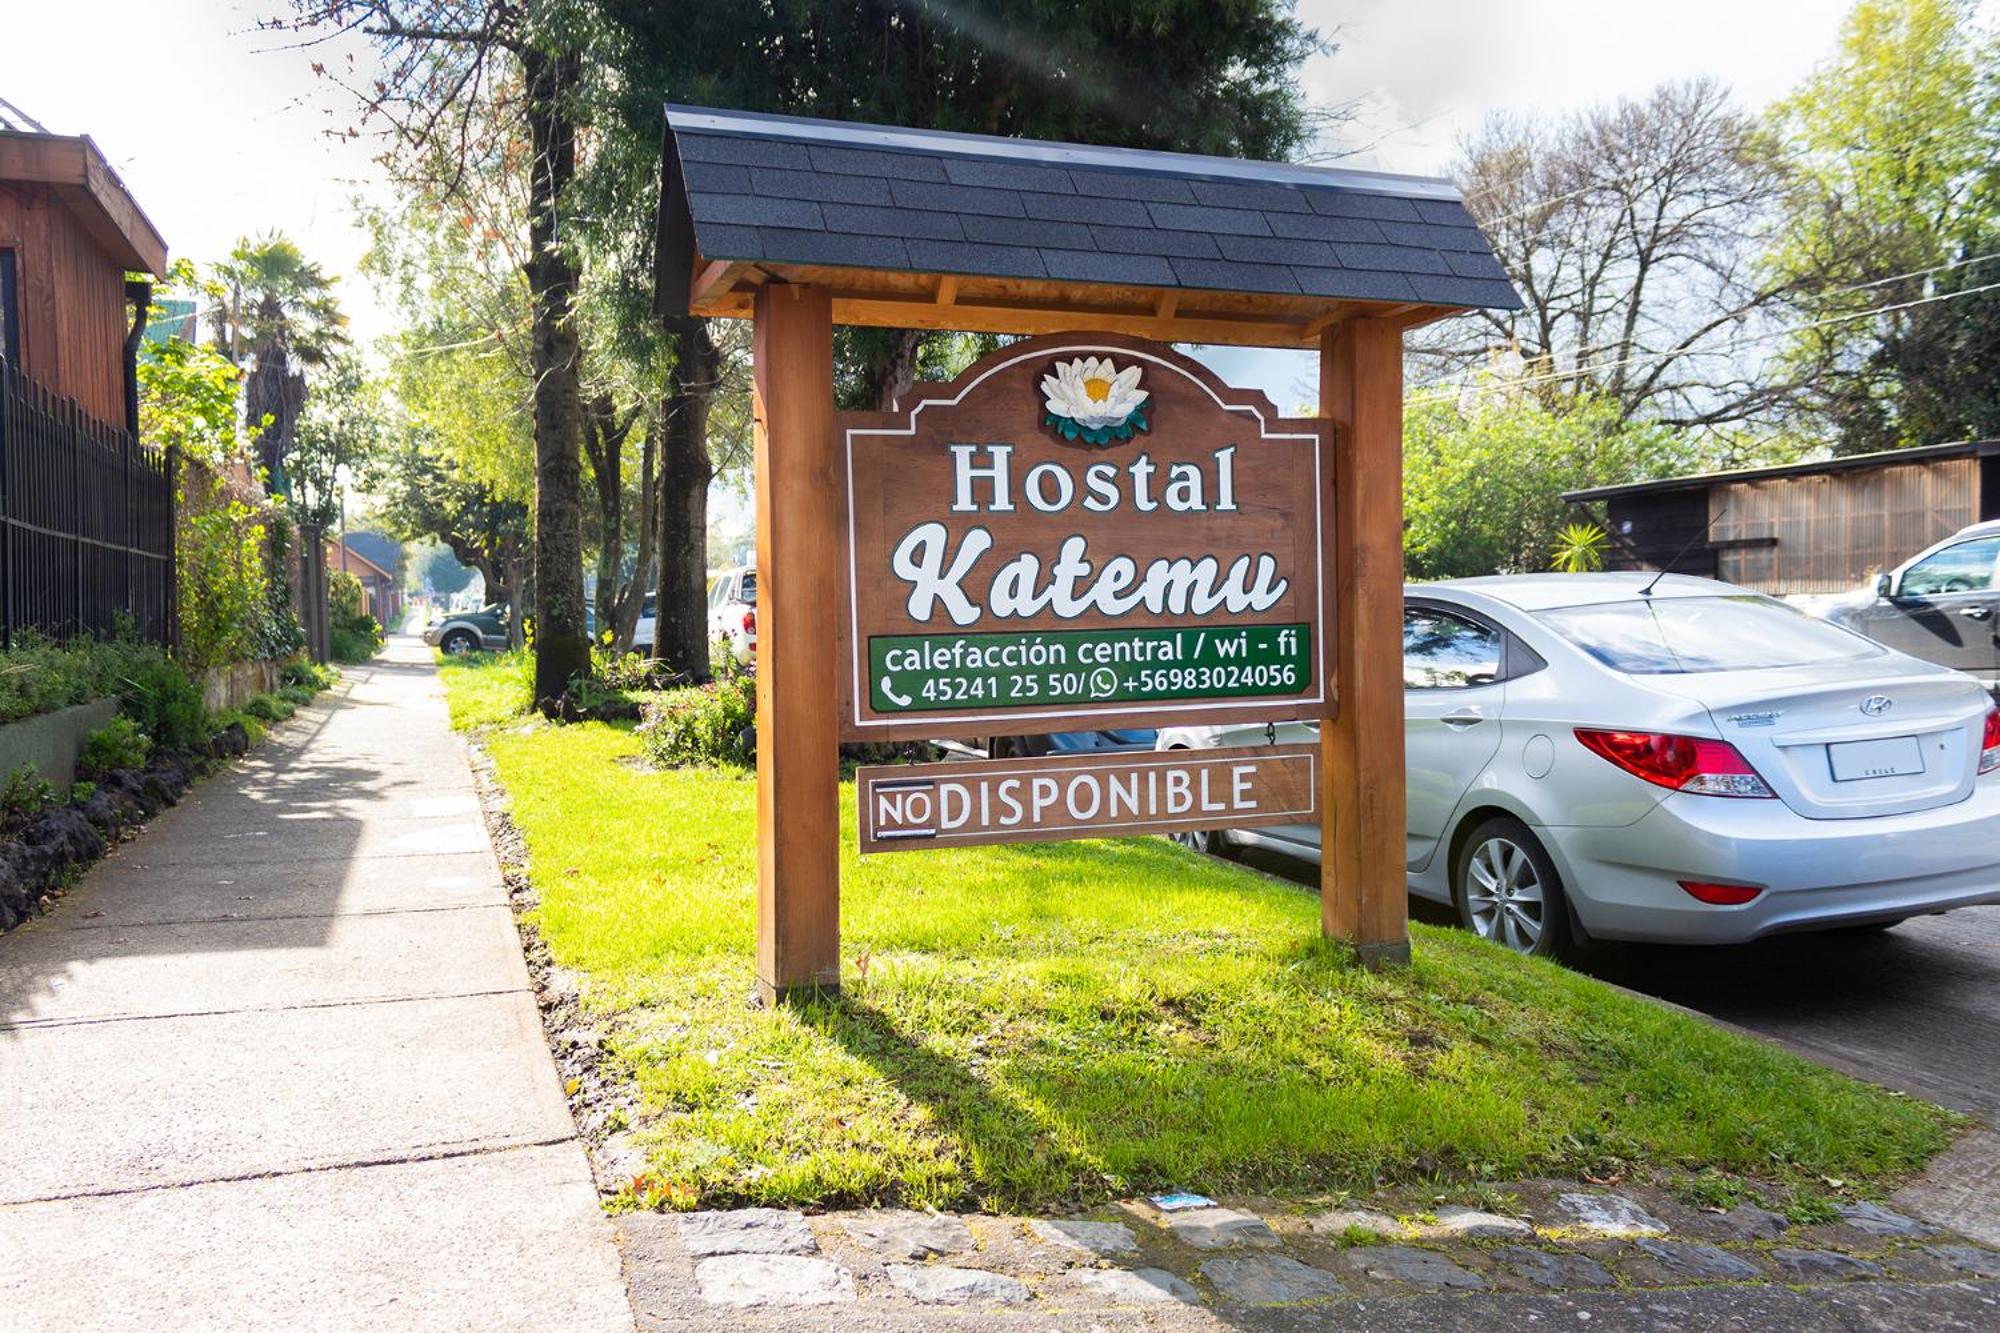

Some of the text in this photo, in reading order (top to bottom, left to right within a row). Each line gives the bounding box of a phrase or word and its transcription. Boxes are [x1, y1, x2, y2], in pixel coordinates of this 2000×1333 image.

[949, 443, 1237, 512] Hostal
[893, 522, 1288, 625] Katemu
[885, 638, 1066, 671] calefacción
[1078, 633, 1183, 664] central
[921, 677, 998, 701] 45241
[1009, 674, 1039, 697] 25
[1123, 664, 1296, 692] +56983024056
[879, 765, 1257, 829] NO DISPONIBLE
